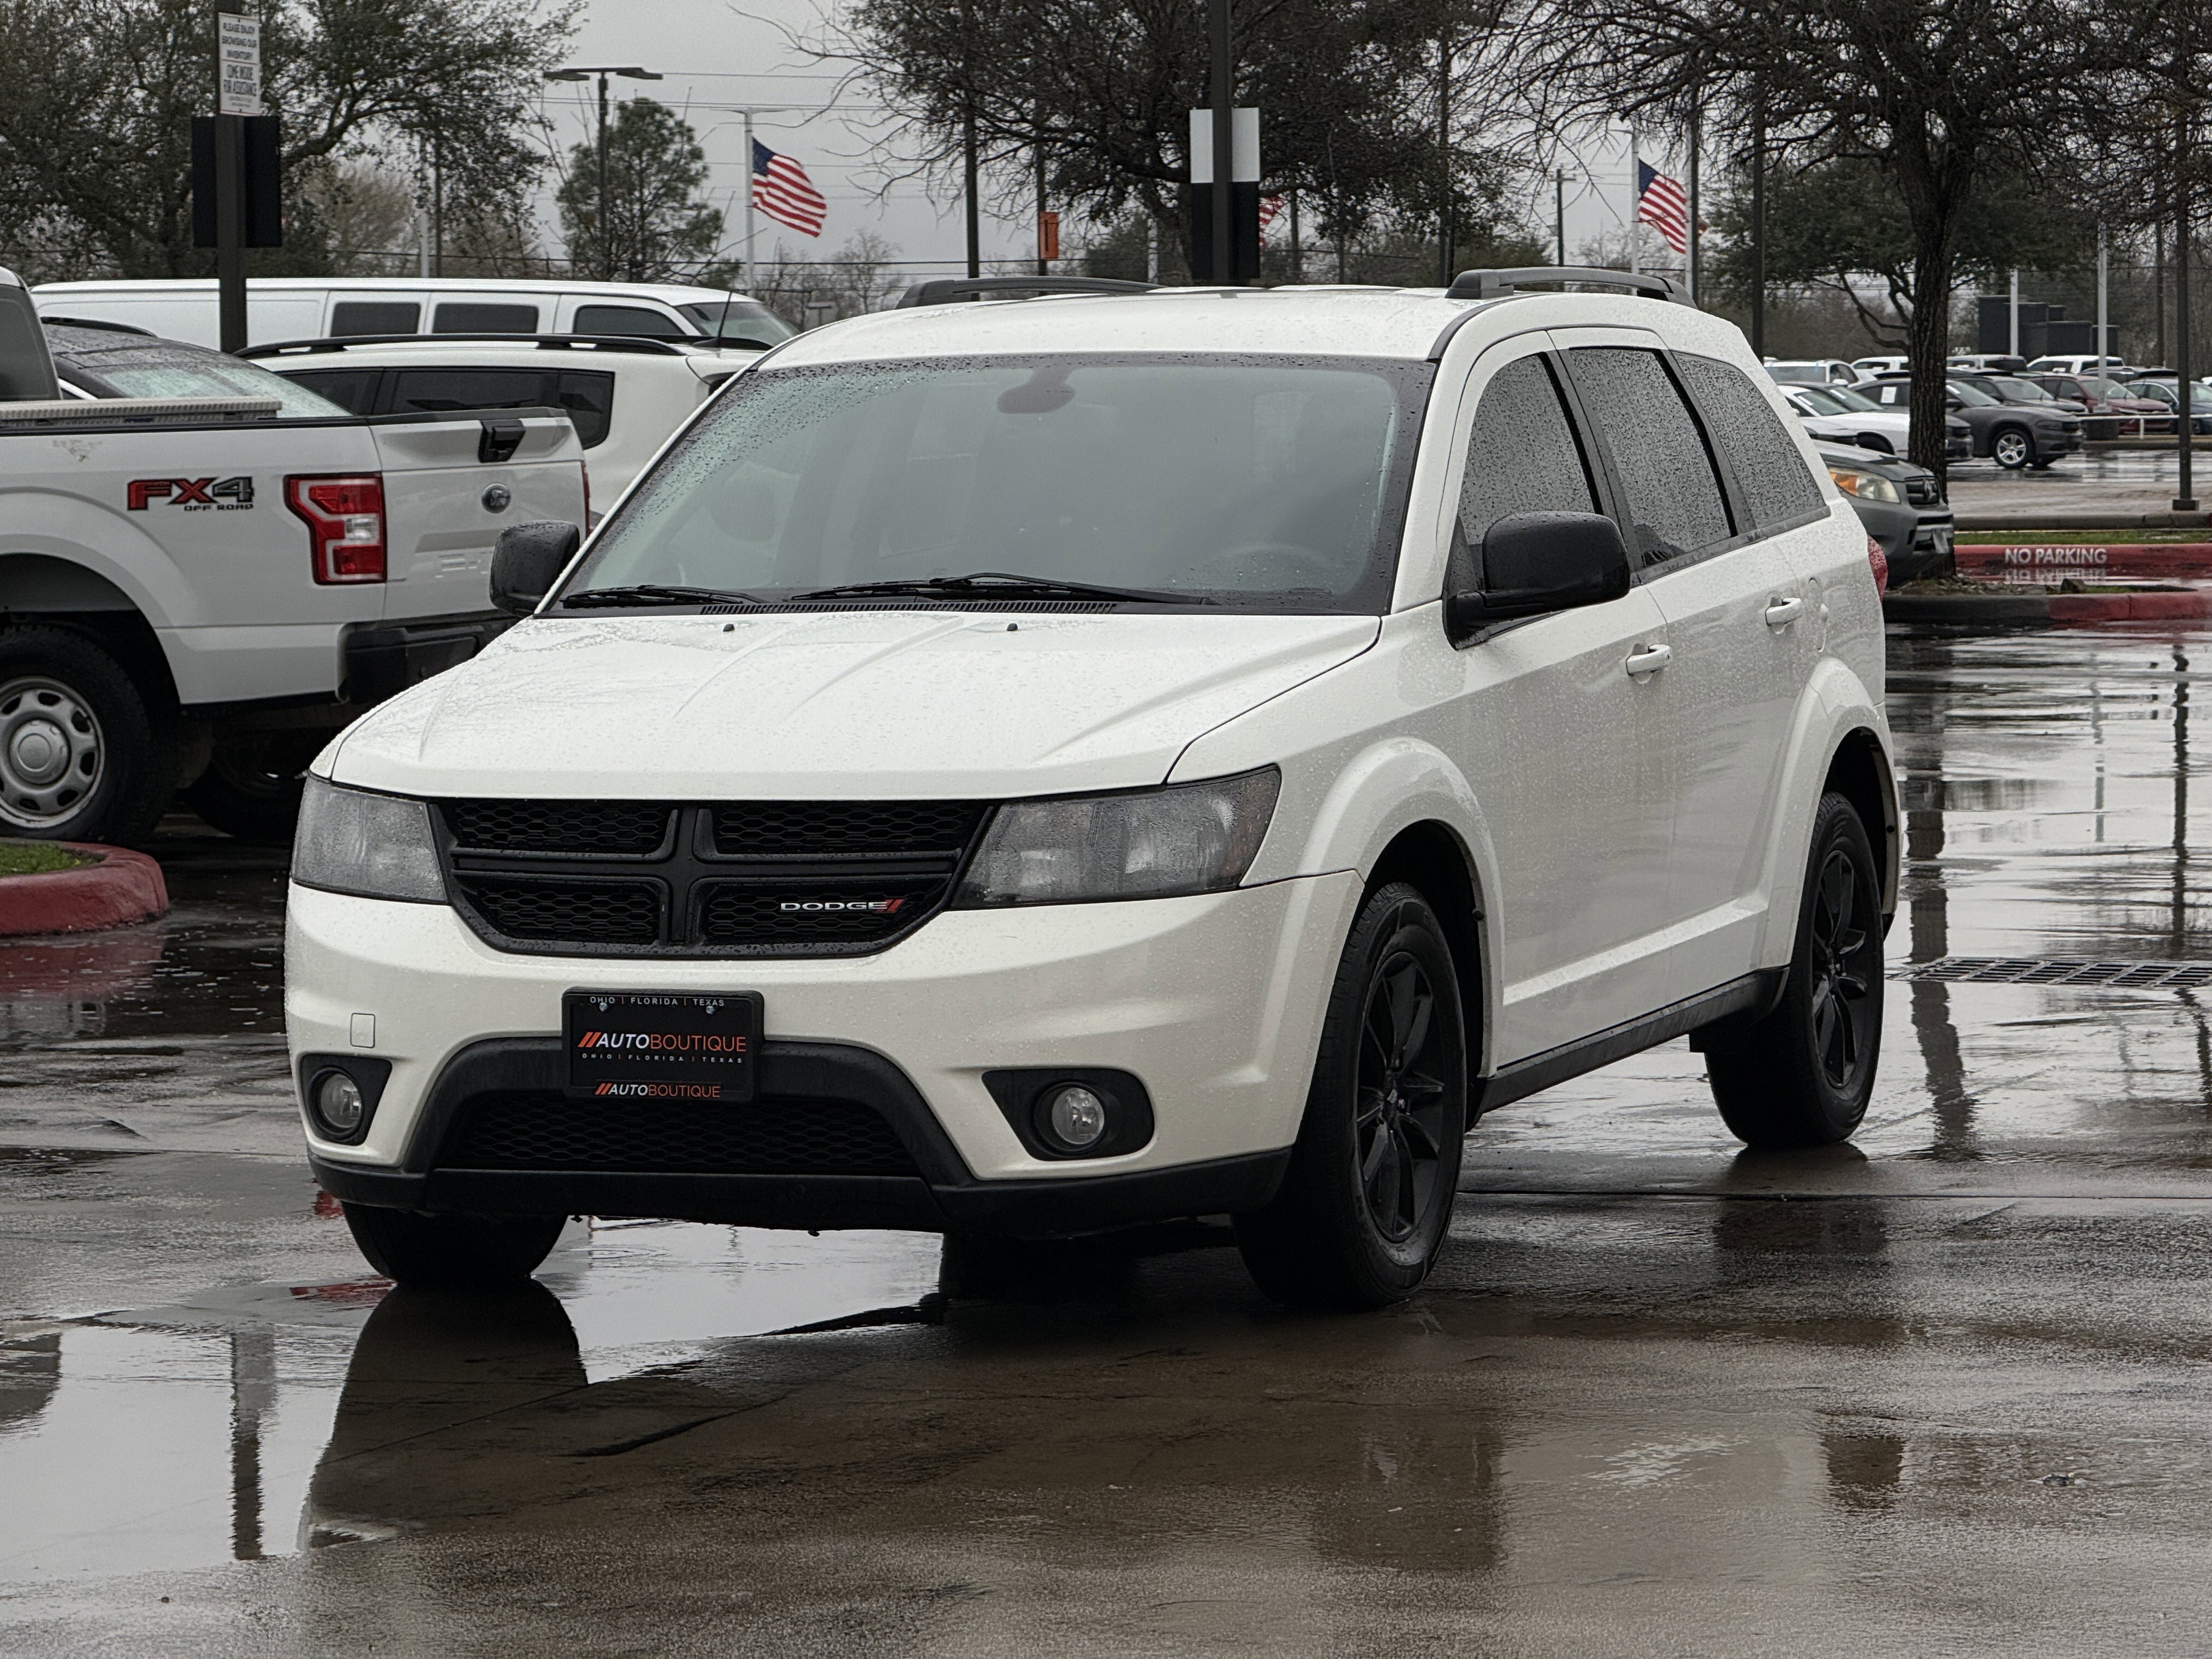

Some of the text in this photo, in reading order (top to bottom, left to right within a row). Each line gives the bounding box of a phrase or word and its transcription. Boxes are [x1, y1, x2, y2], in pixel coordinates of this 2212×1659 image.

[127, 476, 253, 510] FX4
[2005, 548, 2107, 564] NO PARKING
[781, 902, 888, 910] DODGE
[631, 997, 678, 1006] FLORIDA
